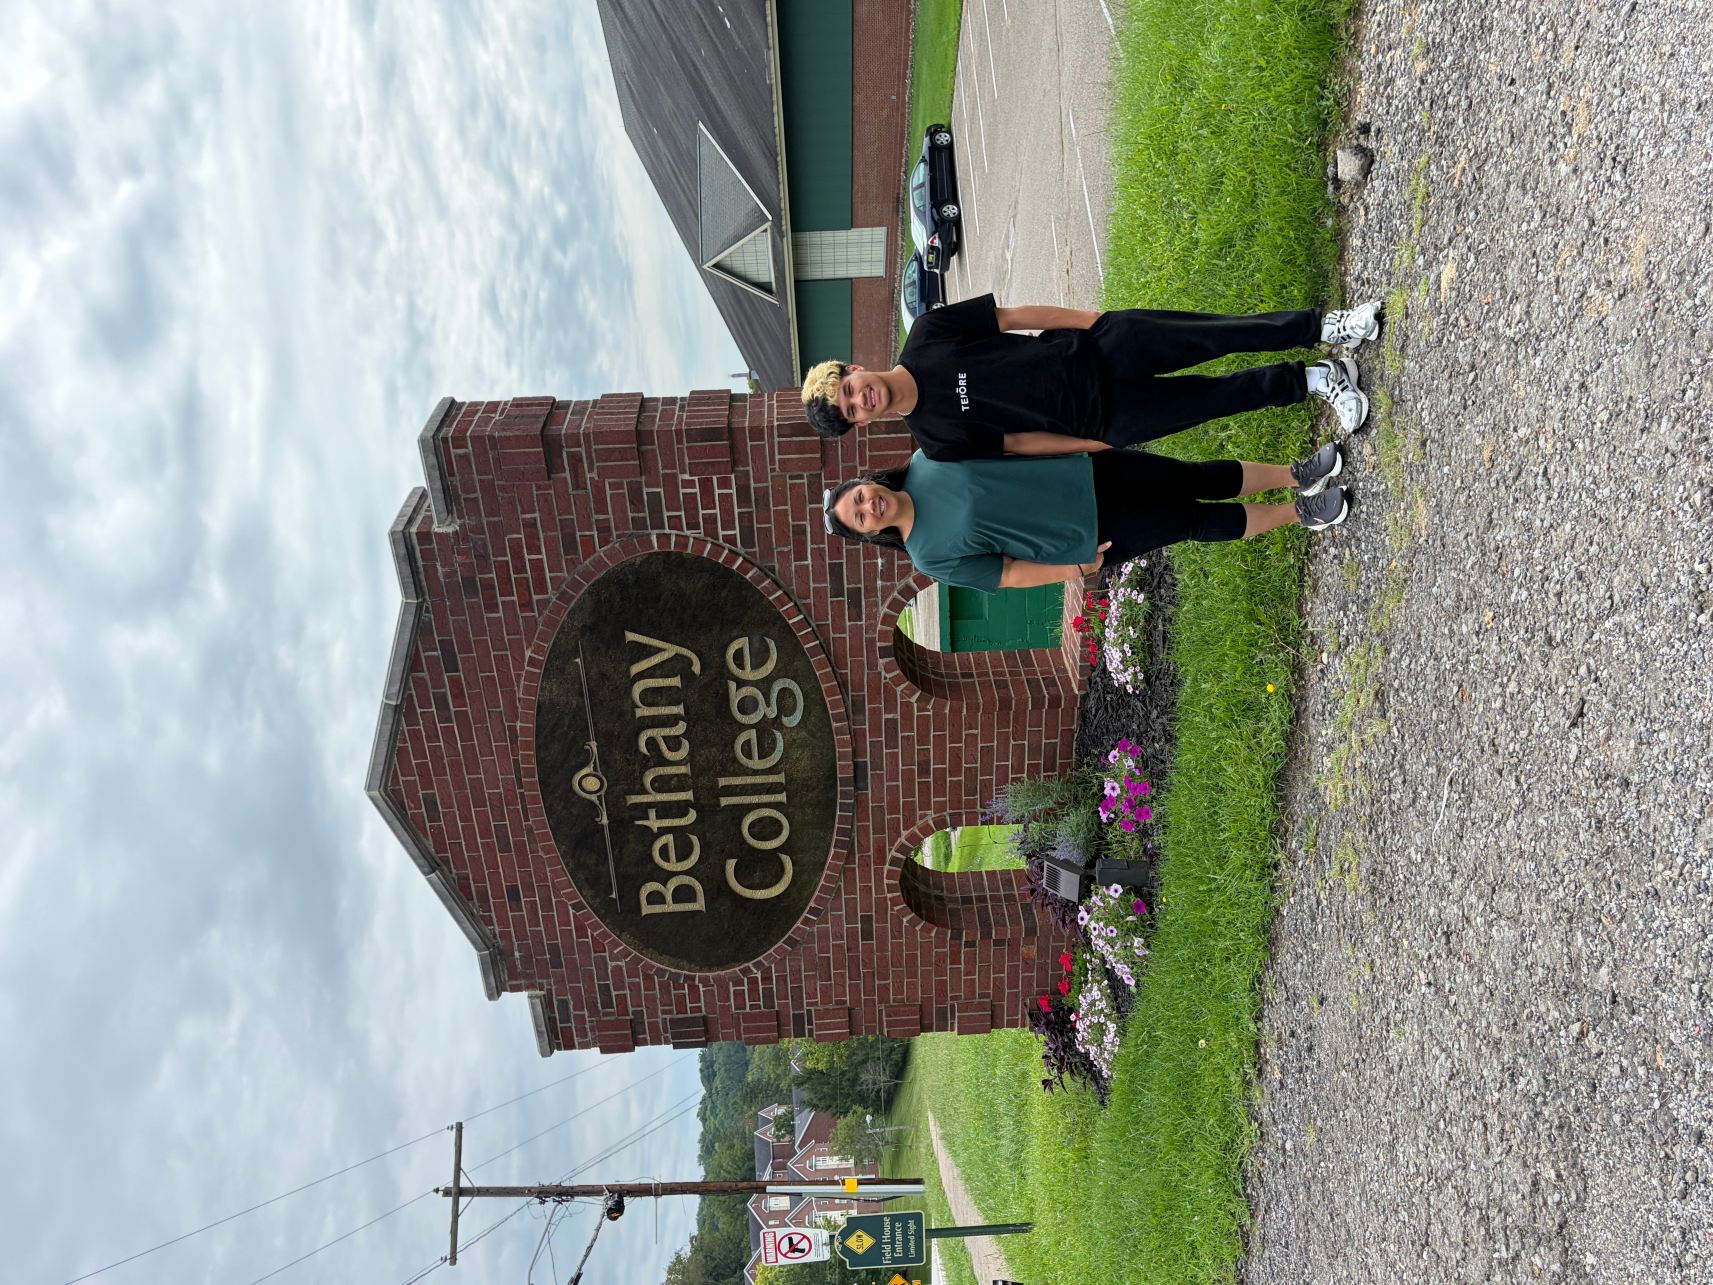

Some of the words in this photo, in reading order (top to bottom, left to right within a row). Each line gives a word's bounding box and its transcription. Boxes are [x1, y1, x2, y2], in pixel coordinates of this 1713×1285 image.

[624, 629, 707, 917] Bethany
[717, 635, 804, 900] College
[881, 1216, 891, 1242] House
[894, 1221, 903, 1257] Entrance
[907, 1219, 917, 1235] Sight
[764, 1232, 776, 1263] WARNING
[856, 1234, 864, 1250] SLOW
[882, 1244, 892, 1264] Field
[907, 1235, 916, 1258] Limited
